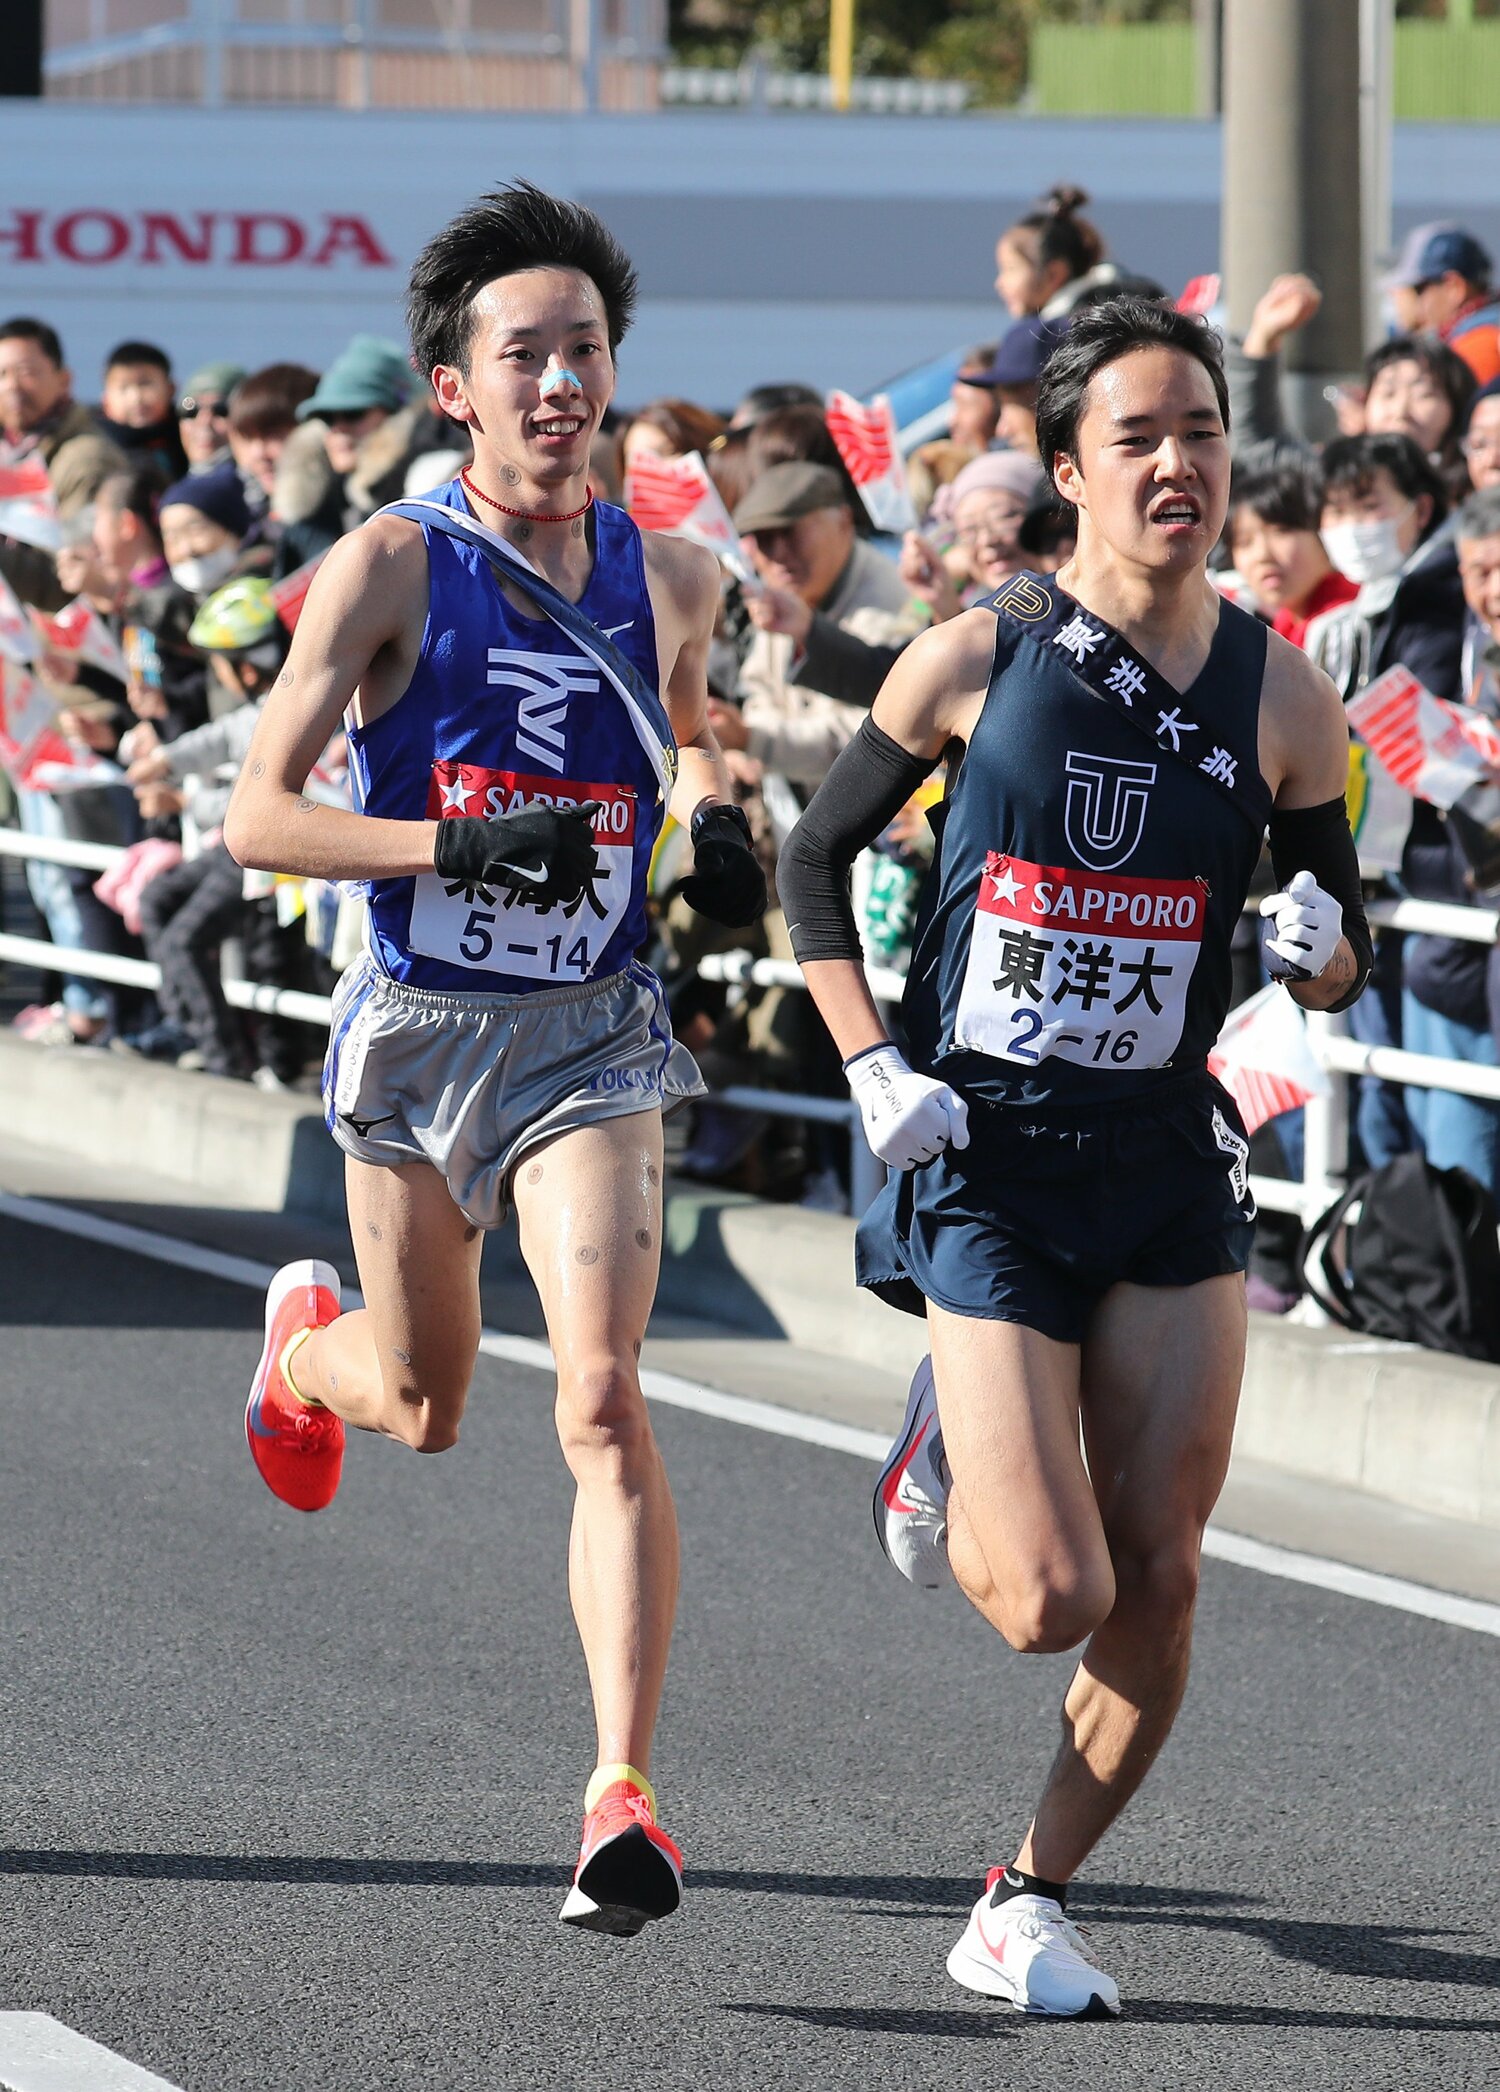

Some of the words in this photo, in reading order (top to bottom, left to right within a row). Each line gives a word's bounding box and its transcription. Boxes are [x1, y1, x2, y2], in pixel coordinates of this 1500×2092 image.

[1053, 615, 1238, 790] 東洋大学
[482, 785, 629, 834] SARO
[1030, 881, 1197, 929] SAPPORO
[992, 929, 1174, 1017] 東洋大
[868, 1060, 892, 1089] TOYO
